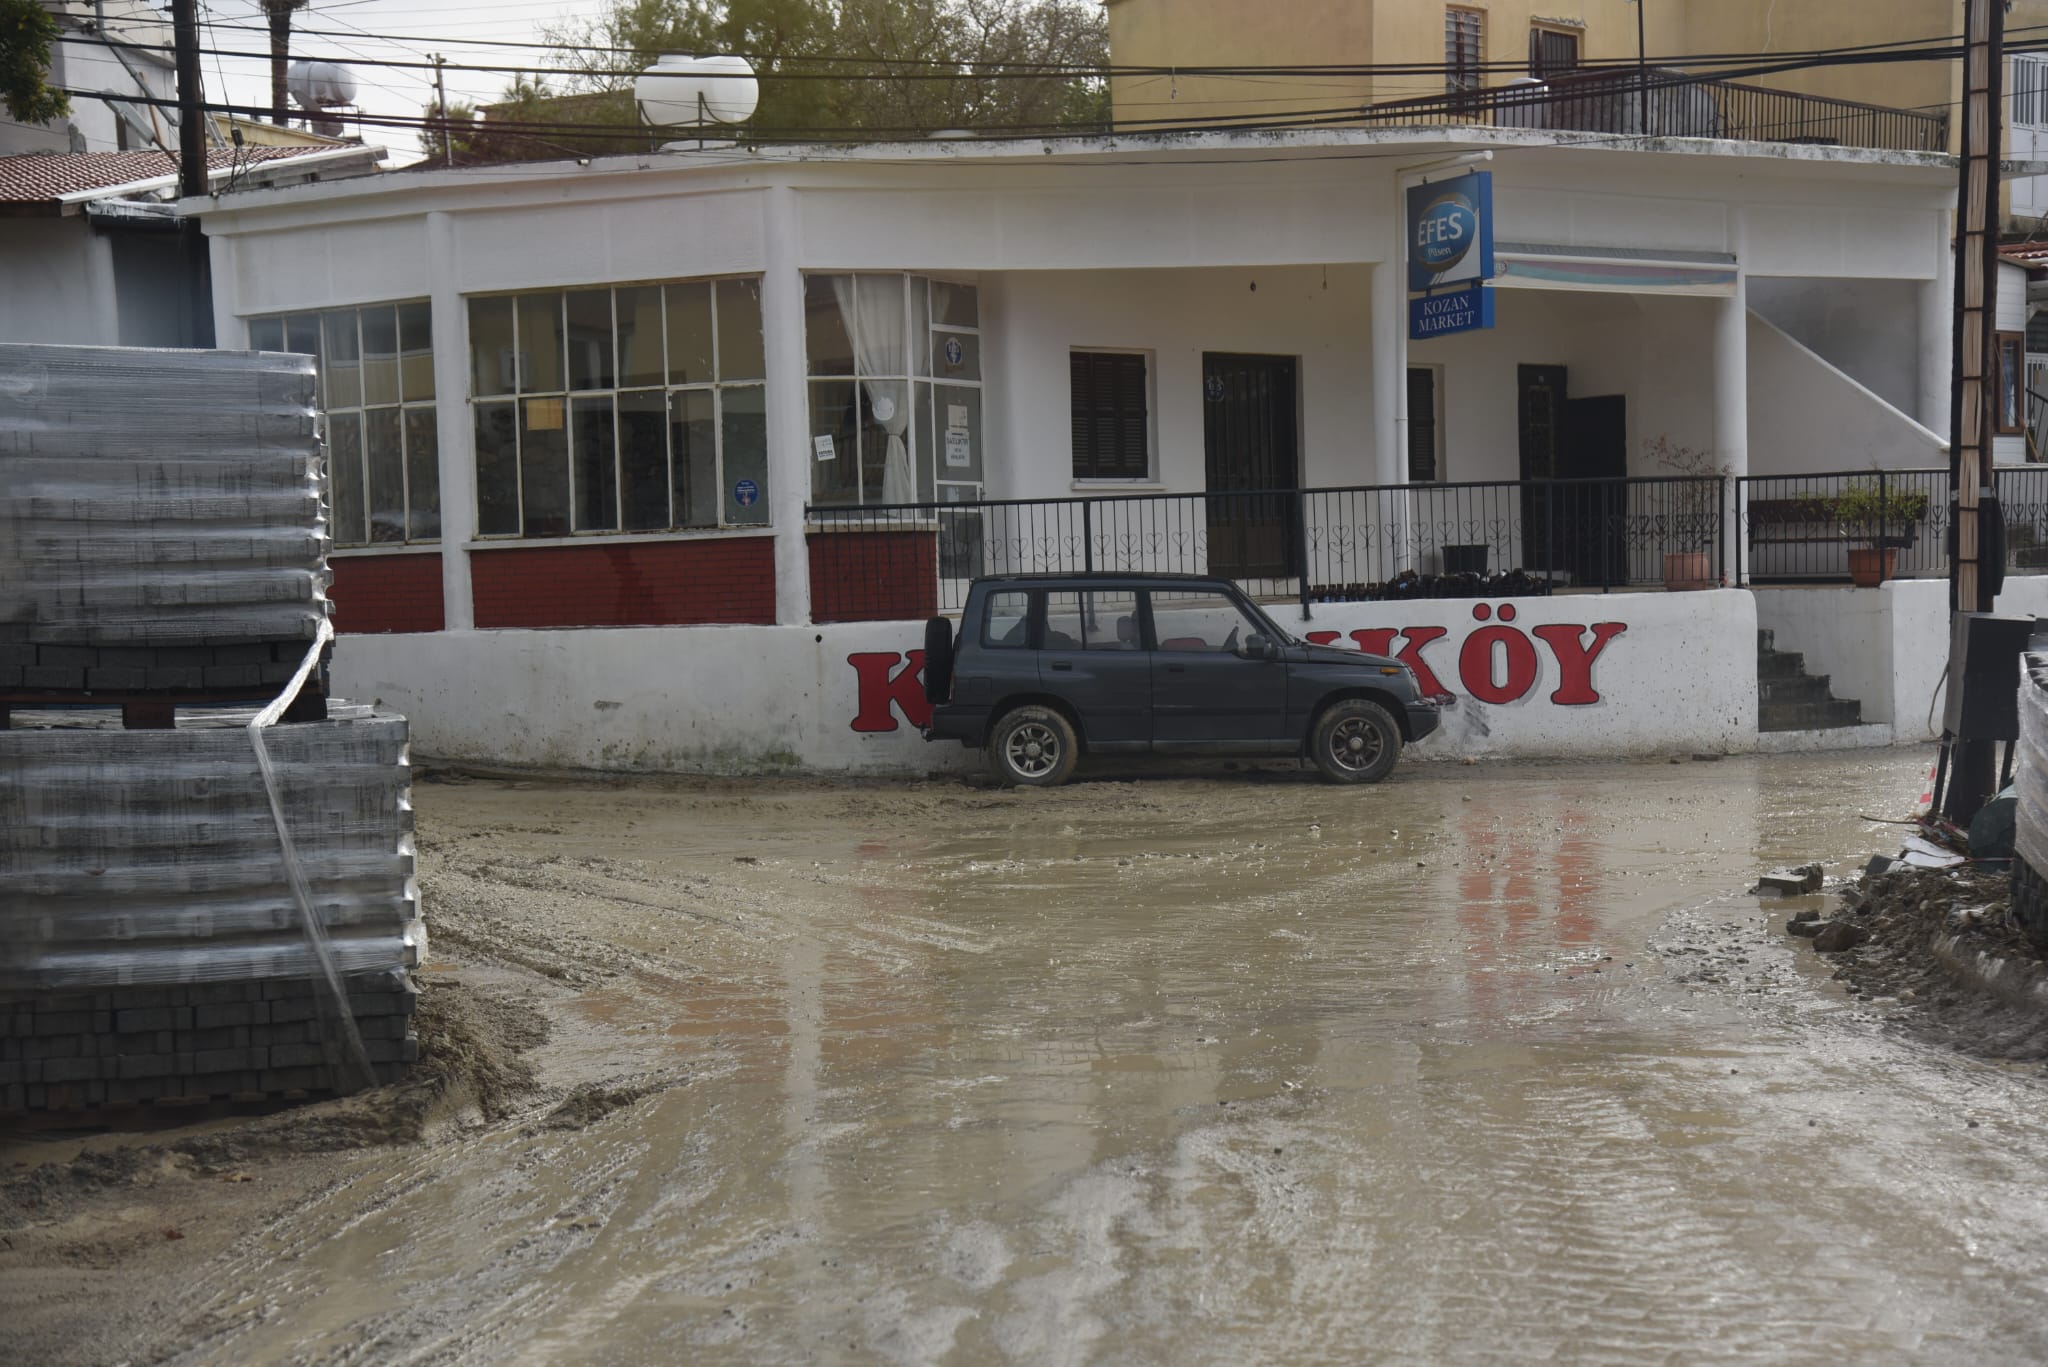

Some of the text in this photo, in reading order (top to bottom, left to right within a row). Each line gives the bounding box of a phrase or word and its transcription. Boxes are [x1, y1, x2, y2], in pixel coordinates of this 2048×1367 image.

[1418, 212, 1463, 246] EFES
[1423, 295, 1470, 316] KOZAN
[1418, 310, 1475, 333] MARKET
